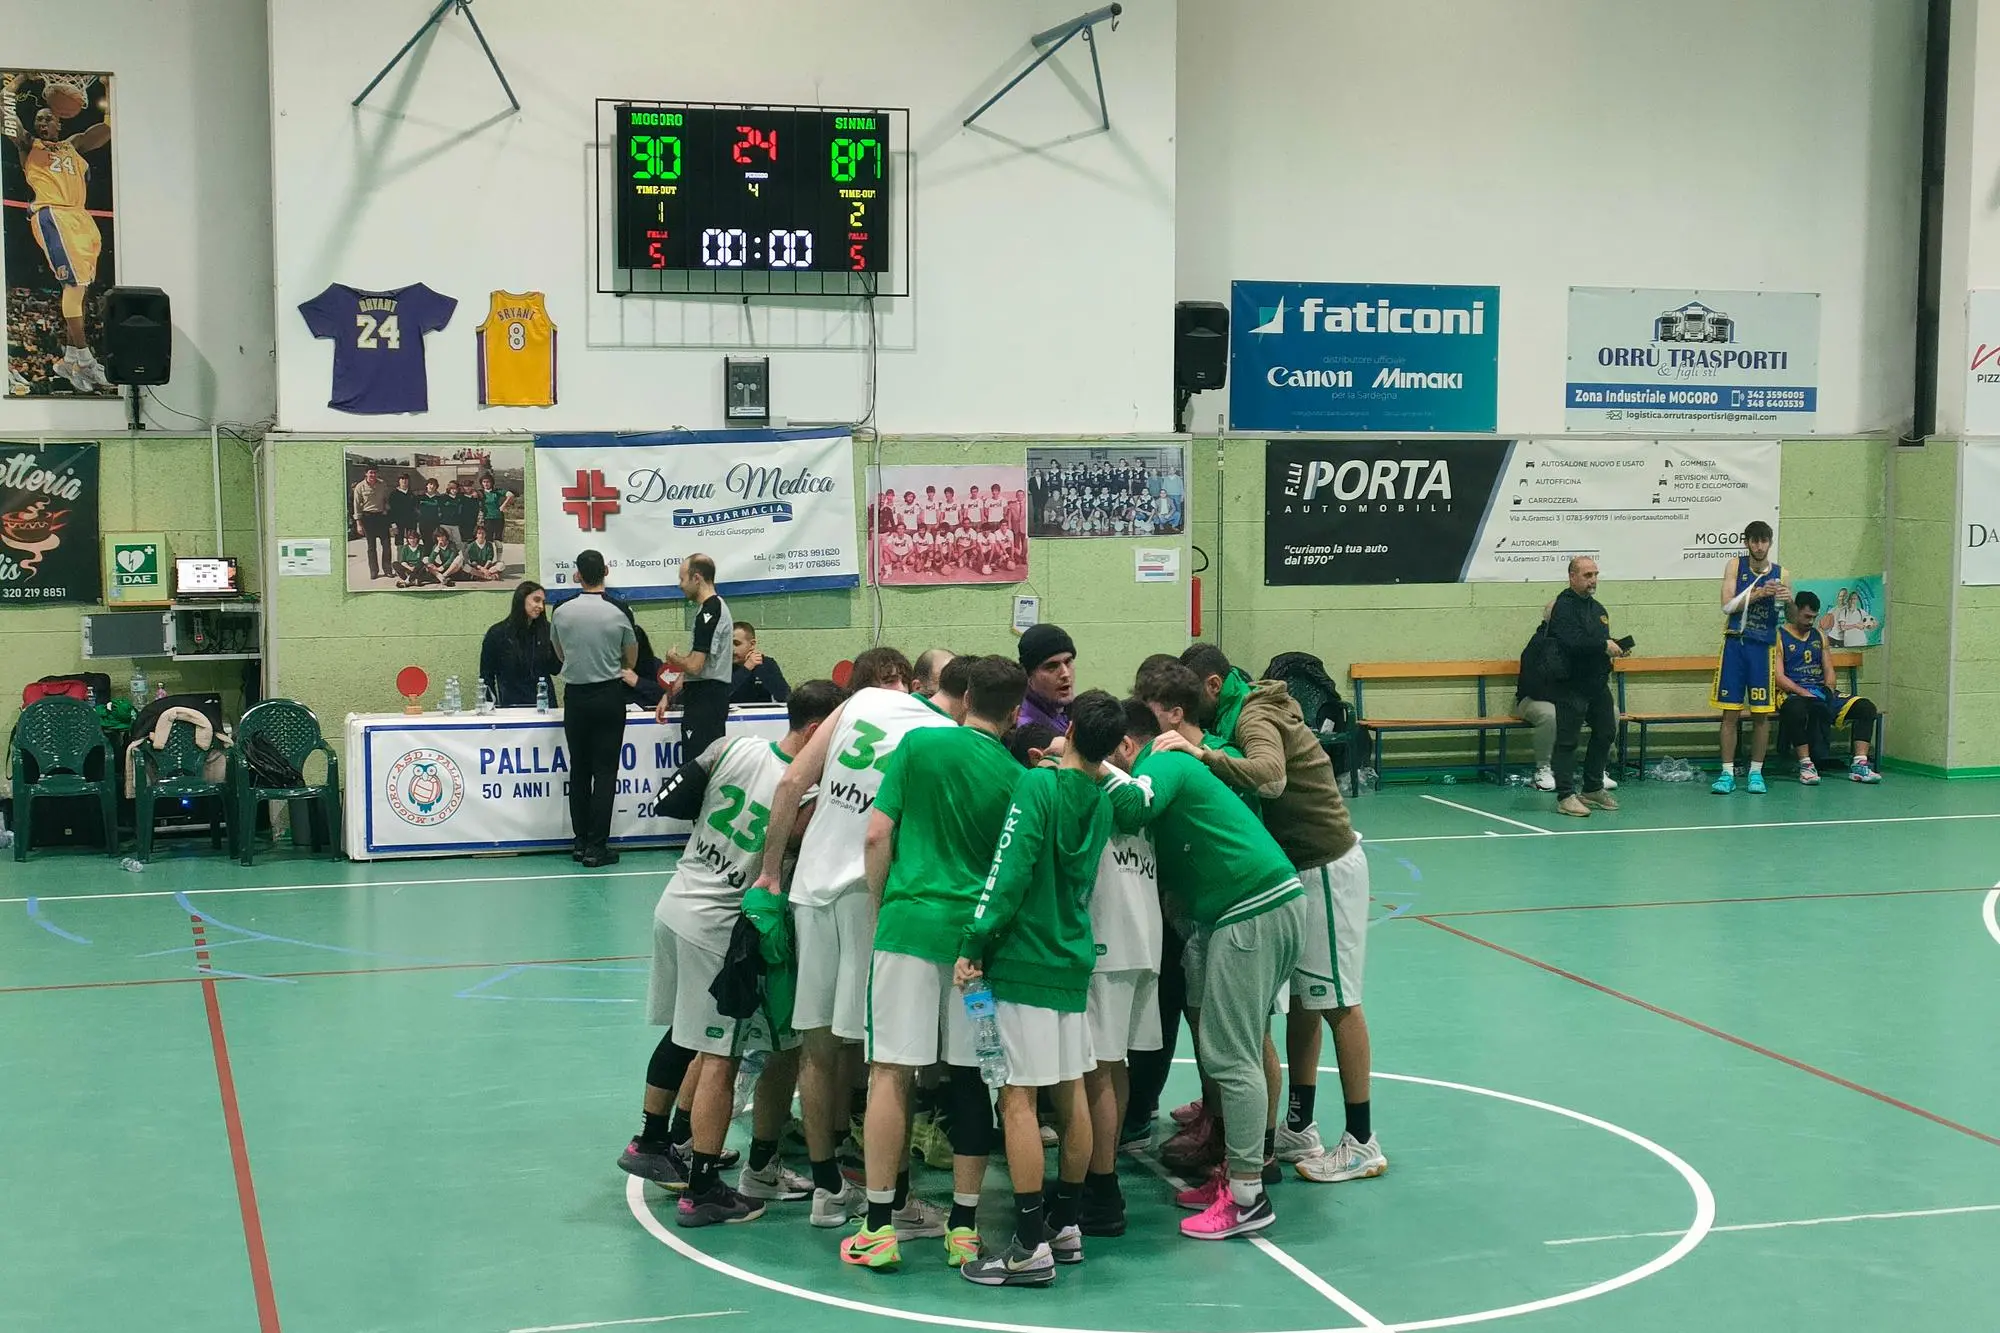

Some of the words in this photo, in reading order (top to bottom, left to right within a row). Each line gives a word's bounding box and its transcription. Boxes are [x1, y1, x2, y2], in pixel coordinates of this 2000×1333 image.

[632, 113, 682, 126] MOGORO
[835, 117, 876, 130] SINNAI
[733, 126, 776, 163] 24
[631, 136, 680, 179] 90
[831, 138, 881, 182] 87
[50, 156, 75, 174] 24
[636, 186, 677, 194] TIME-OUT
[748, 183, 759, 197] 4
[839, 190, 876, 198] TIME-OUT
[658, 201, 664, 222] 1
[850, 202, 864, 226] 2
[702, 228, 812, 266] 00:00
[649, 242, 665, 268] 5
[850, 244, 866, 270] 5
[358, 298, 398, 312] BRYANT
[497, 308, 535, 320] BRYANT
[1300, 298, 1484, 334] faticoni
[356, 314, 400, 348] 24
[508, 322, 525, 350] 8
[1598, 344, 1660, 367] ORRÙ
[1668, 349, 1788, 370] TRASPORTI
[1267, 366, 1352, 387] Canon
[1357, 392, 1398, 400] Sardegna
[1575, 390, 1602, 402] Zona
[1606, 390, 1666, 403] Industriale
[1669, 391, 1718, 404] MOGORO
[1748, 390, 1764, 398] 342
[1766, 391, 1804, 400] 3596005
[1747, 400, 1764, 408] 348
[1766, 400, 1804, 408] 6403539
[1626, 412, 1776, 422] logistica.orrutrasportisrl@gmail.com
[626, 467, 717, 504] Domu
[726, 463, 836, 500] Medica
[1303, 460, 1452, 500] PORTA
[681, 504, 784, 526] PARAFARMACIA
[1284, 504, 1450, 514] AUTOMOBILI
[726, 527, 764, 537] Giuseppina
[1696, 533, 1746, 544] MOGOR
[788, 550, 808, 558] 0783
[810, 548, 840, 557] 991620
[1333, 544, 1342, 554] la
[1346, 544, 1362, 554] tua
[1365, 544, 1388, 553] auto
[556, 561, 570, 569] via
[626, 559, 660, 568] Mogoro
[788, 562, 804, 570] 347
[806, 560, 840, 568] 0763665
[1284, 556, 1301, 565] dal
[123, 575, 152, 584] DAE
[3, 588, 22, 598] 320
[25, 588, 40, 598] 219
[44, 588, 66, 597] 8851
[1751, 688, 1766, 700] 60
[394, 752, 422, 773] ASD
[436, 754, 462, 820] PALLAVOLO
[482, 783, 502, 798] 50
[513, 782, 550, 798] ANNI
[389, 784, 426, 824] MOGORO
[707, 784, 771, 853] 23
